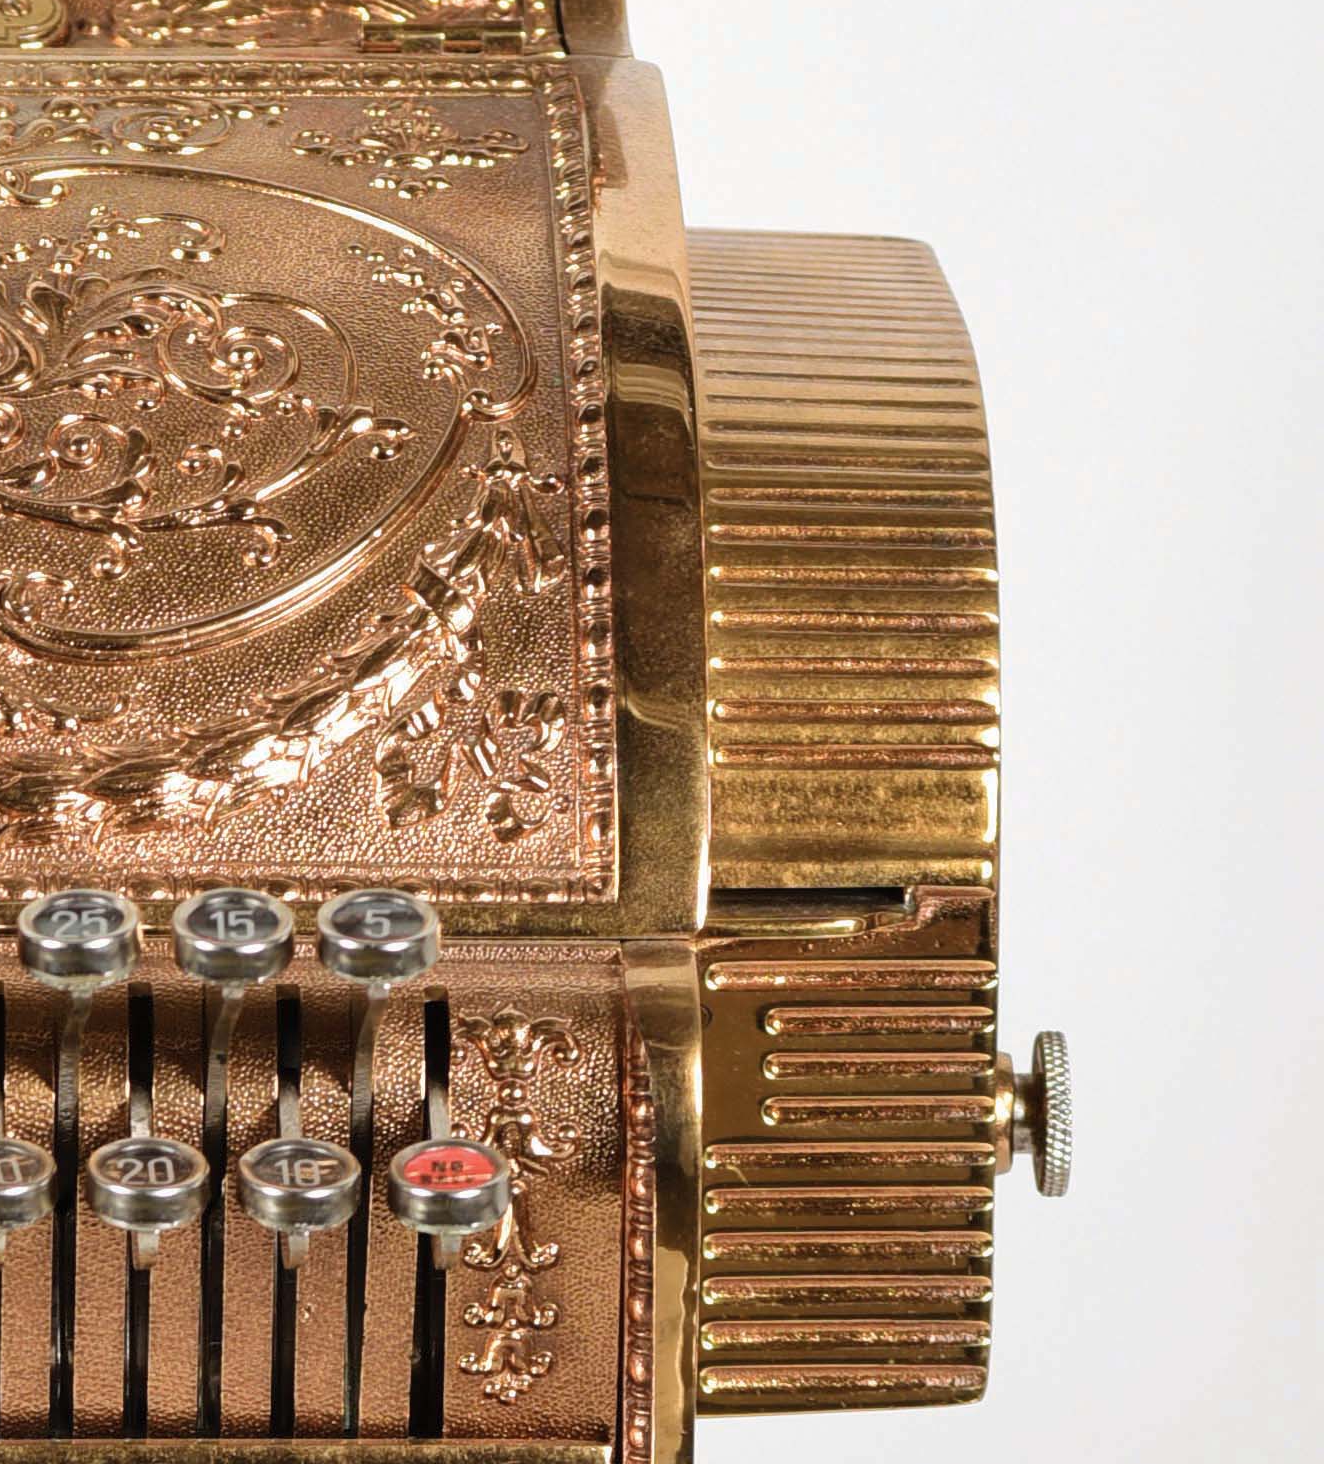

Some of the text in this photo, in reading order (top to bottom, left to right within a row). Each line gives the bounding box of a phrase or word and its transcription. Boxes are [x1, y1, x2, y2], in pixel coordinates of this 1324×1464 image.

[50, 909, 109, 936] 25
[209, 909, 256, 938] 15
[363, 909, 392, 937] 5
[117, 1157, 175, 1187] 20
[274, 1159, 321, 1188] 10
